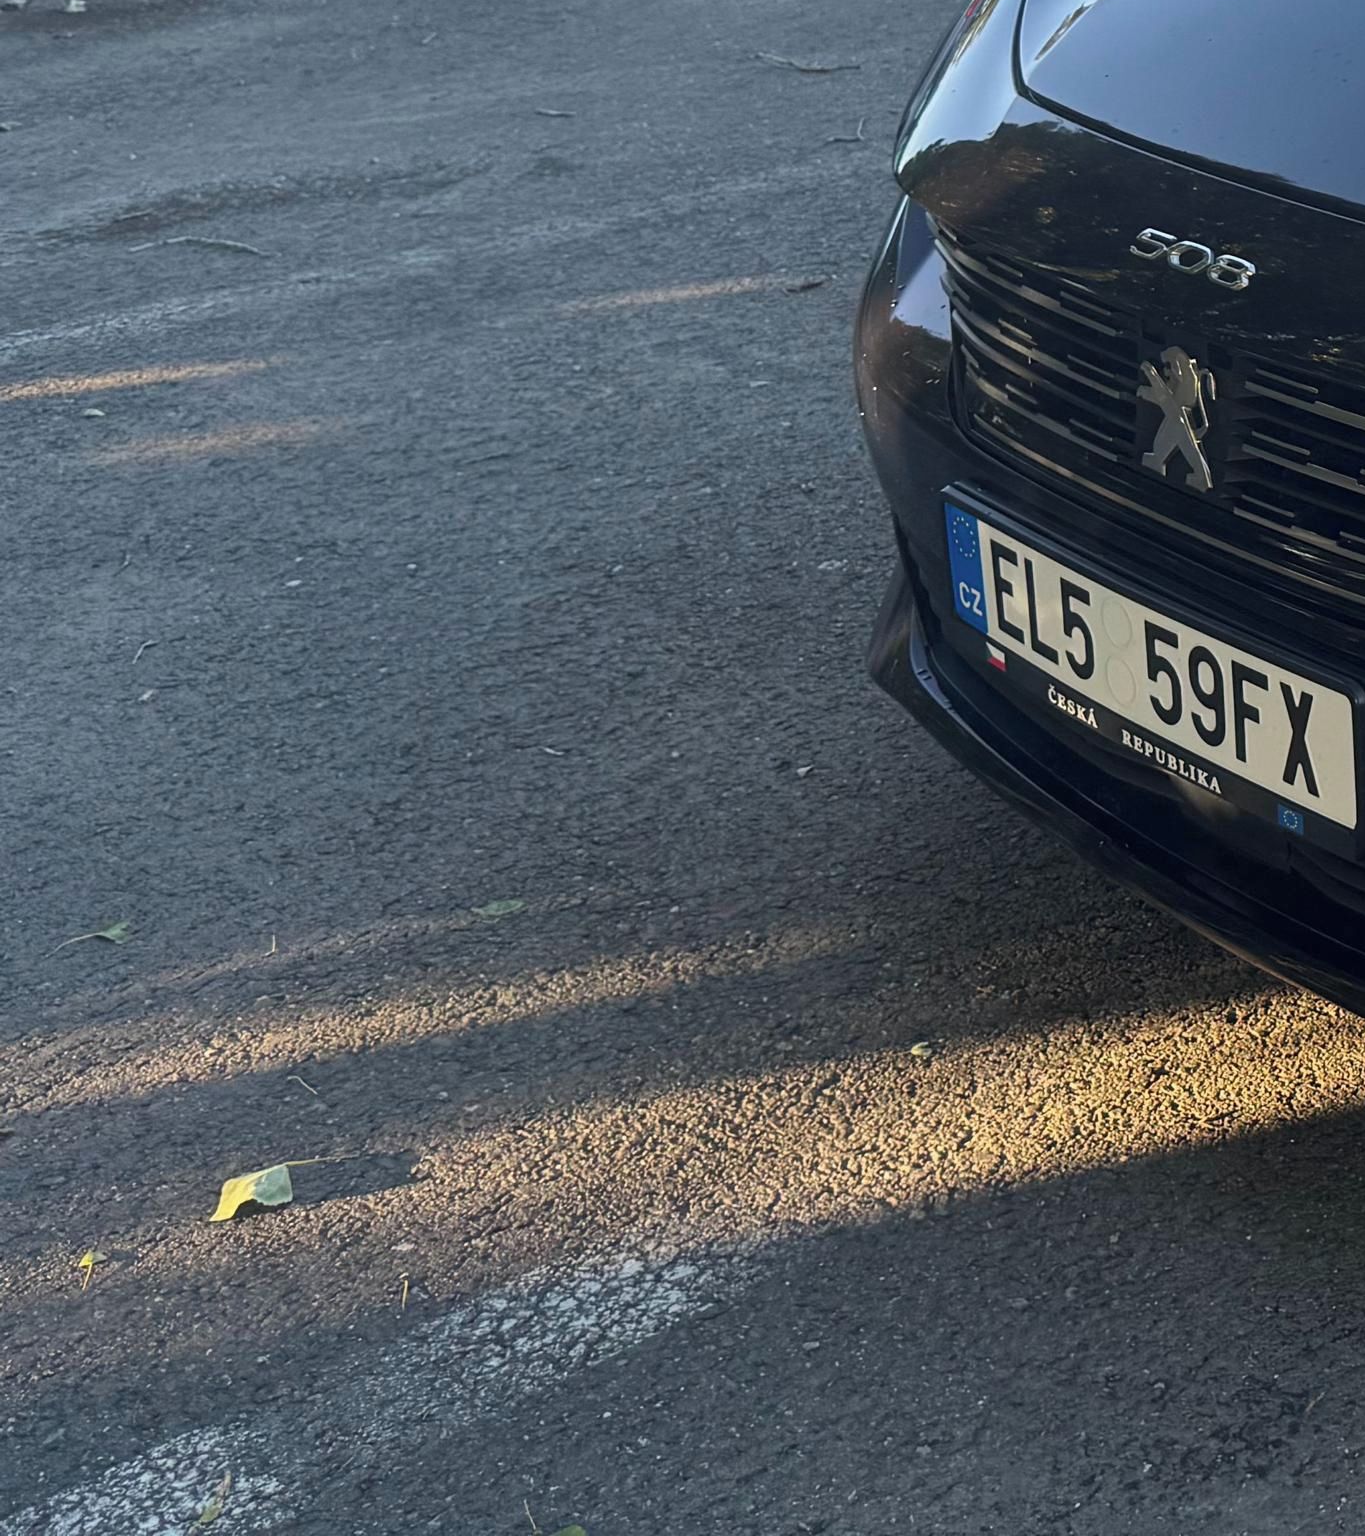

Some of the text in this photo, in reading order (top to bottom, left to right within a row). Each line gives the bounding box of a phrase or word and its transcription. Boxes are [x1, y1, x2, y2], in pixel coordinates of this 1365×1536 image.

[1129, 227, 1256, 290] 508
[958, 580, 984, 617] CZ
[990, 537, 1321, 799] EL5 59FX
[1048, 684, 1222, 795] ČESKÁ REPUBLIKA
